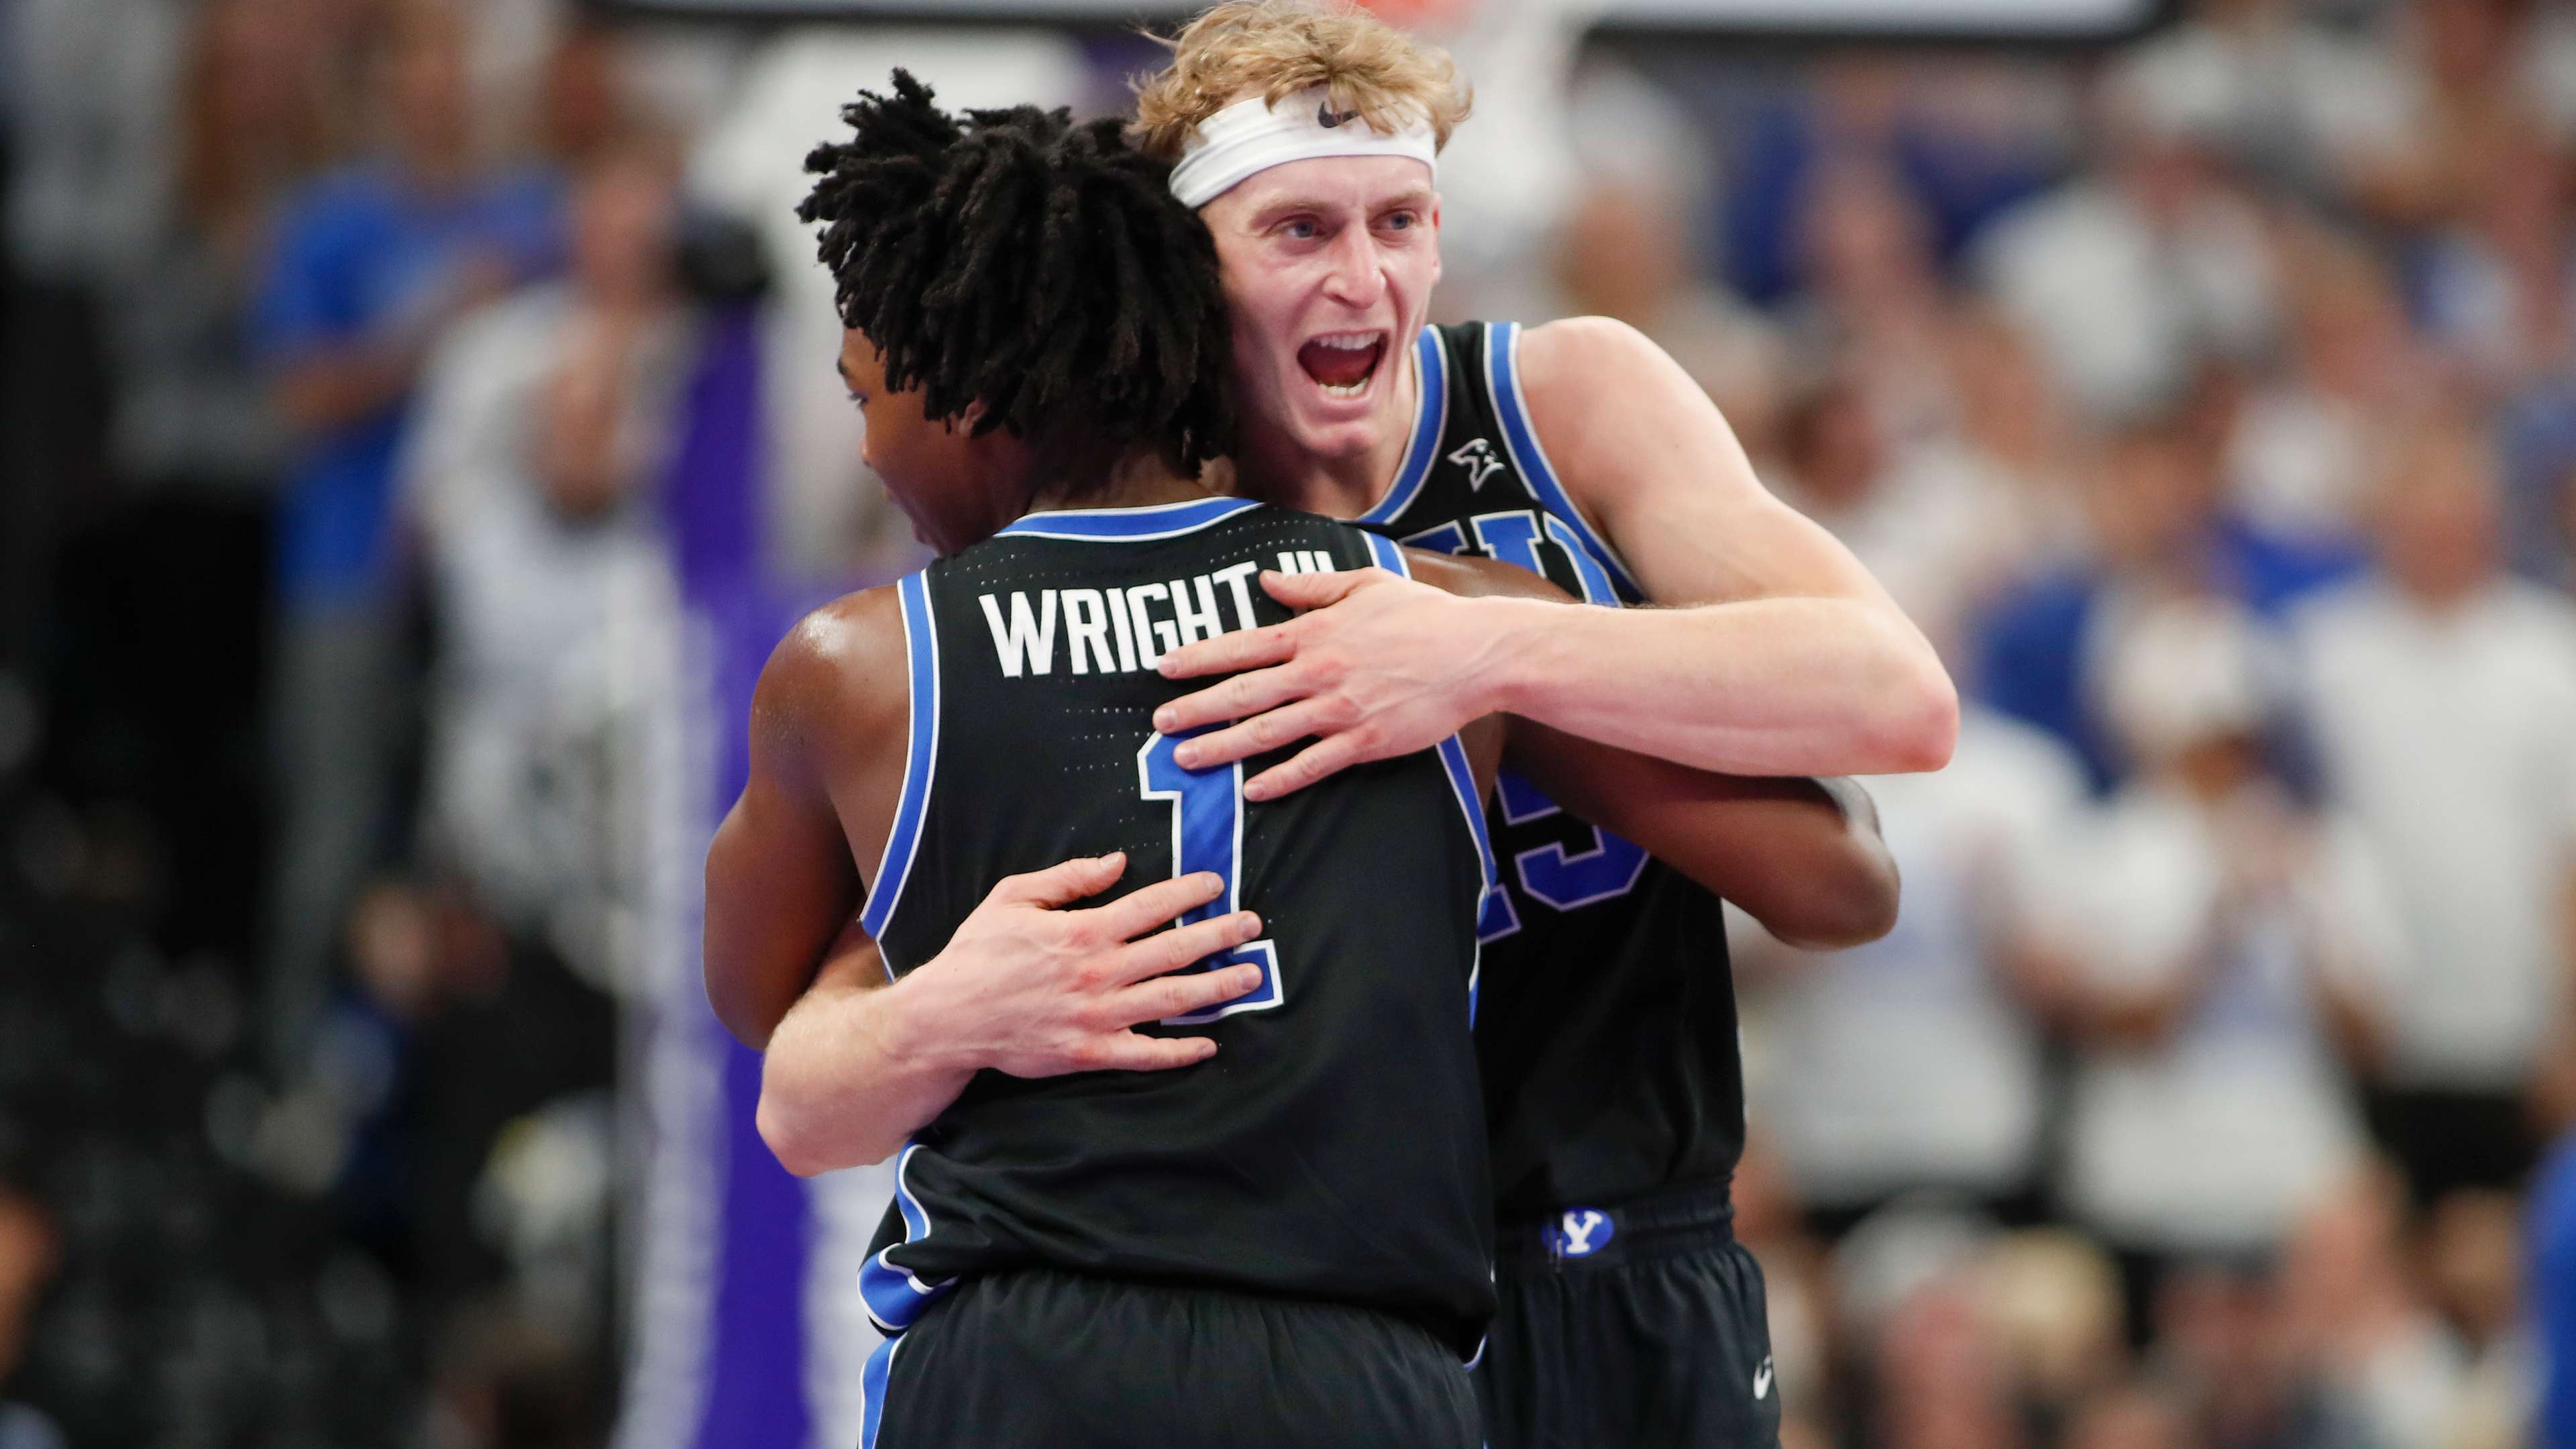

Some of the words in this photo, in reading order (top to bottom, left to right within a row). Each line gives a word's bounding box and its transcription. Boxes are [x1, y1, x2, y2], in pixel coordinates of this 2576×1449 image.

[978, 560, 1258, 678] WRIGHT
[1136, 716, 1285, 1026] 1
[1562, 1210, 1603, 1254] Y
